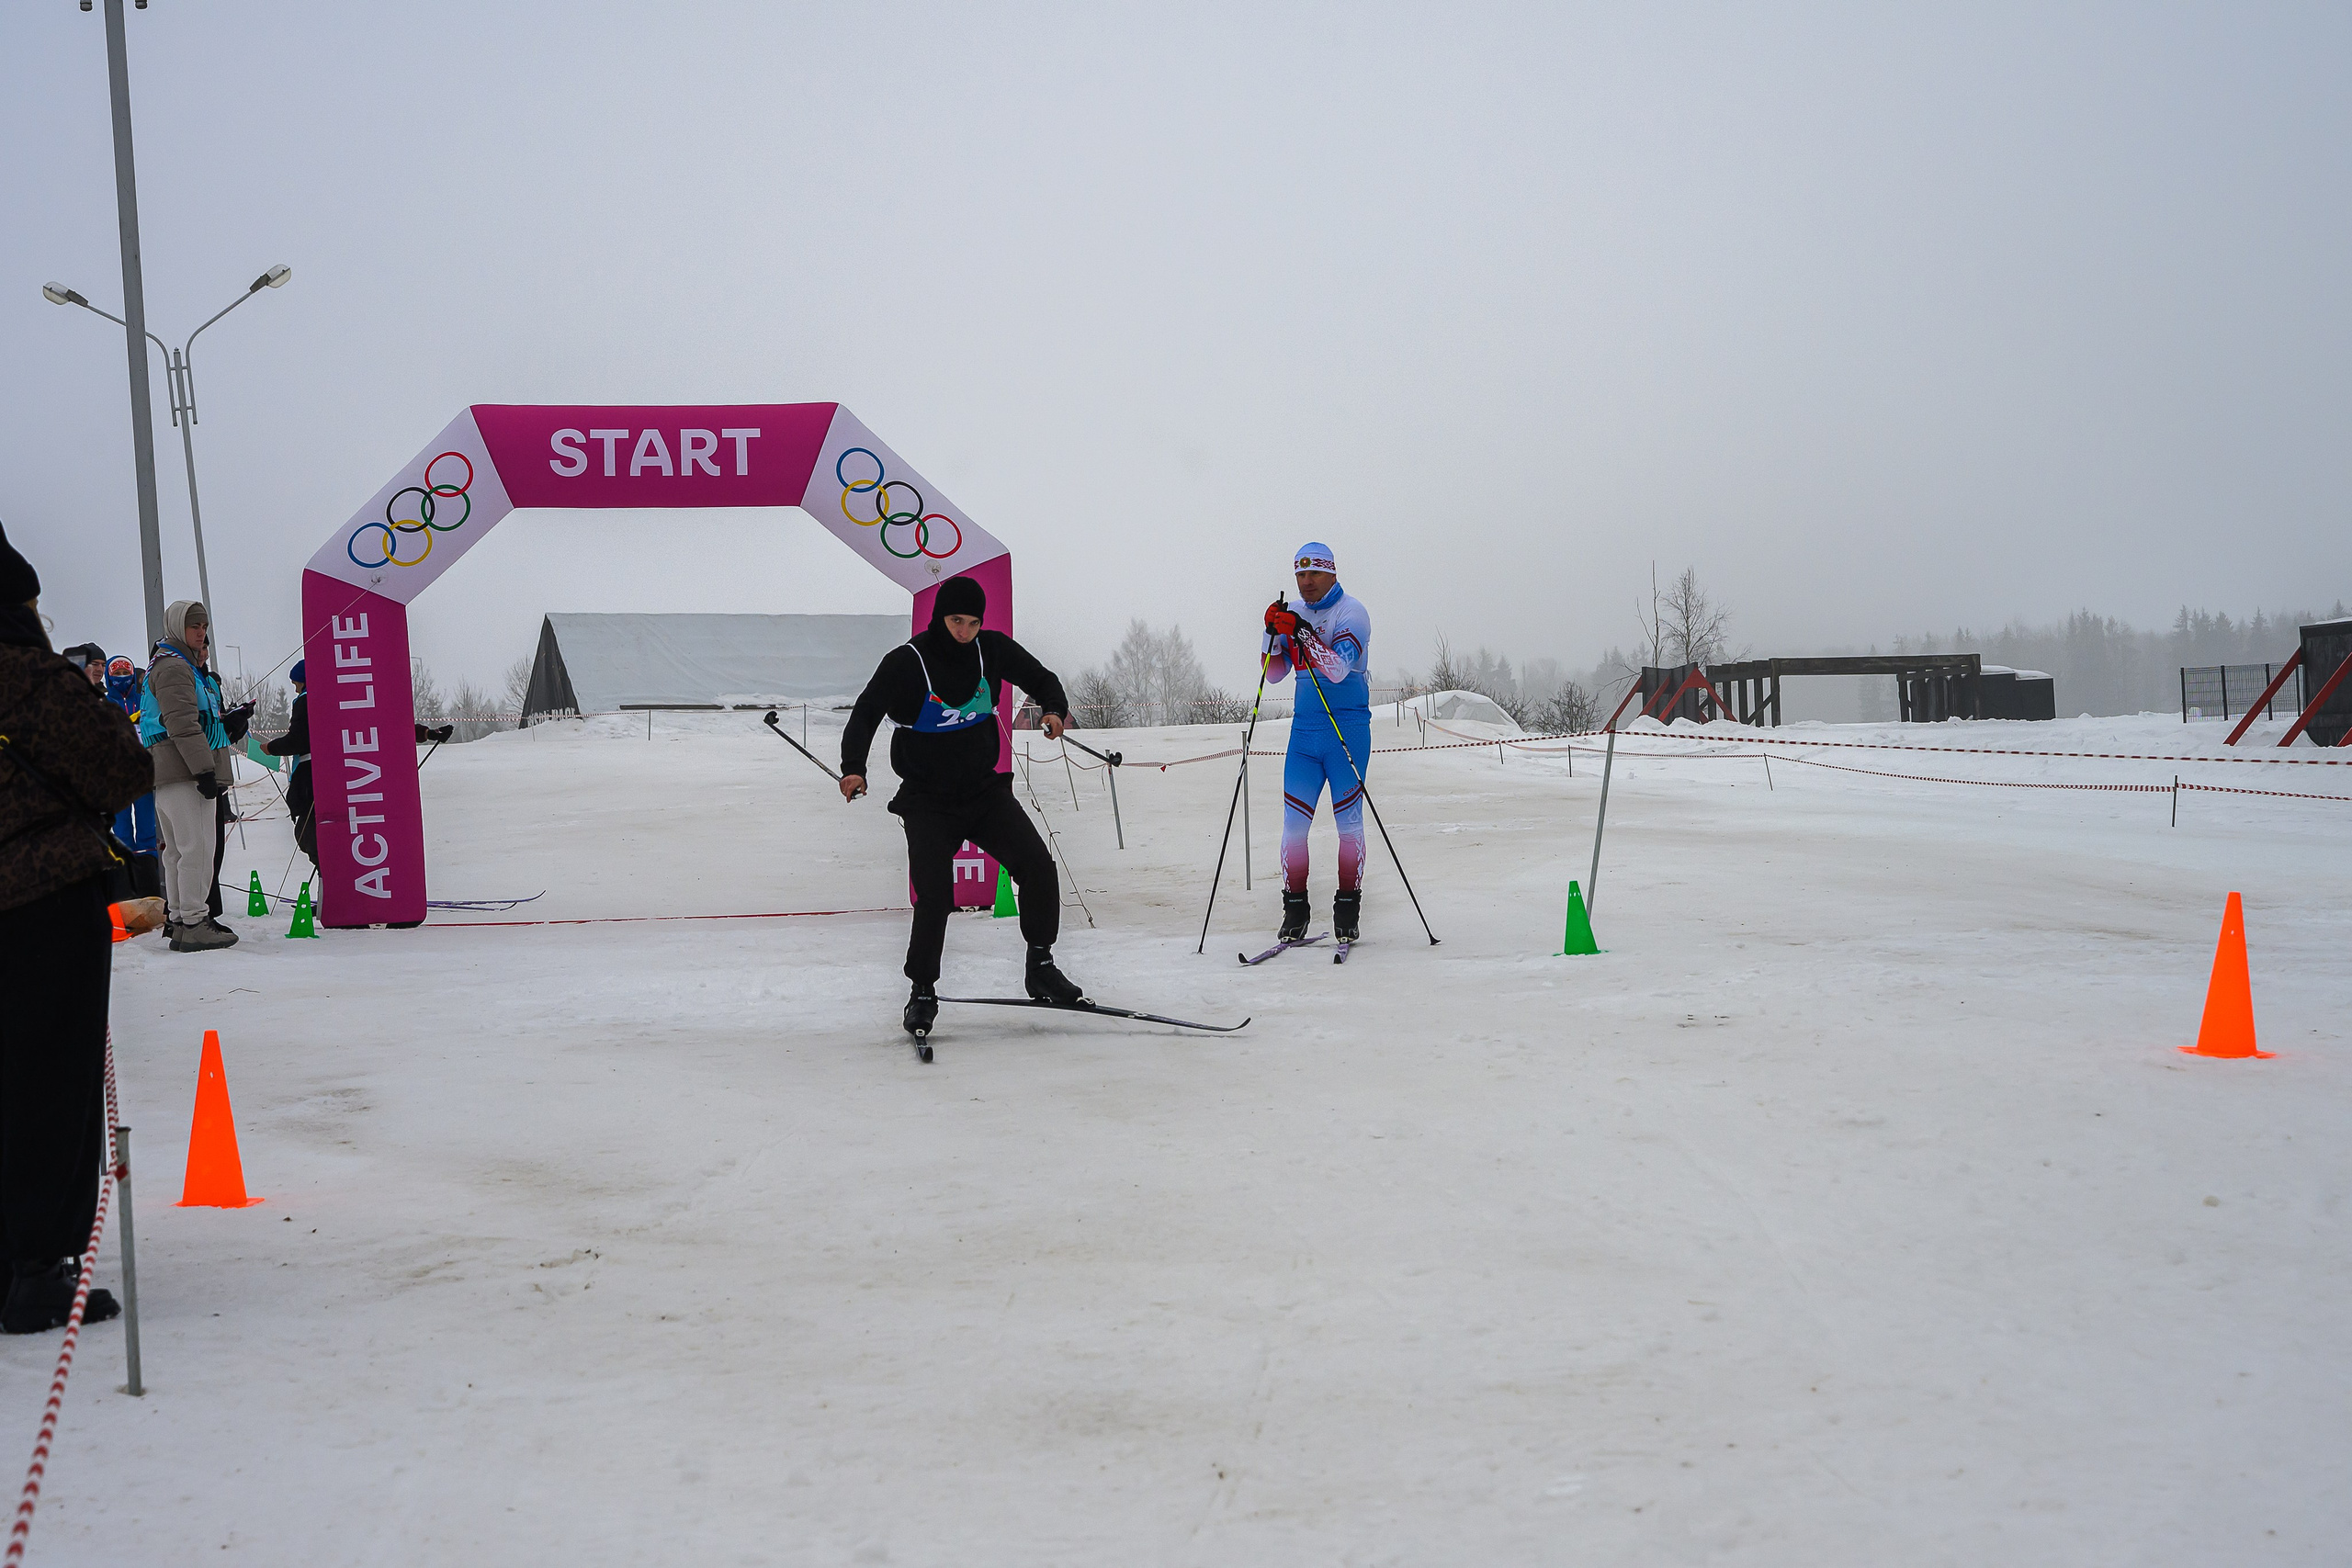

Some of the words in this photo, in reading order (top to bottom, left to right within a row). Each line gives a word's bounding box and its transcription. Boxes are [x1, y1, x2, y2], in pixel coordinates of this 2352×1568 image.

[549, 428, 761, 477] START
[332, 613, 376, 709] LIFE
[341, 727, 391, 898] ACTIVE
